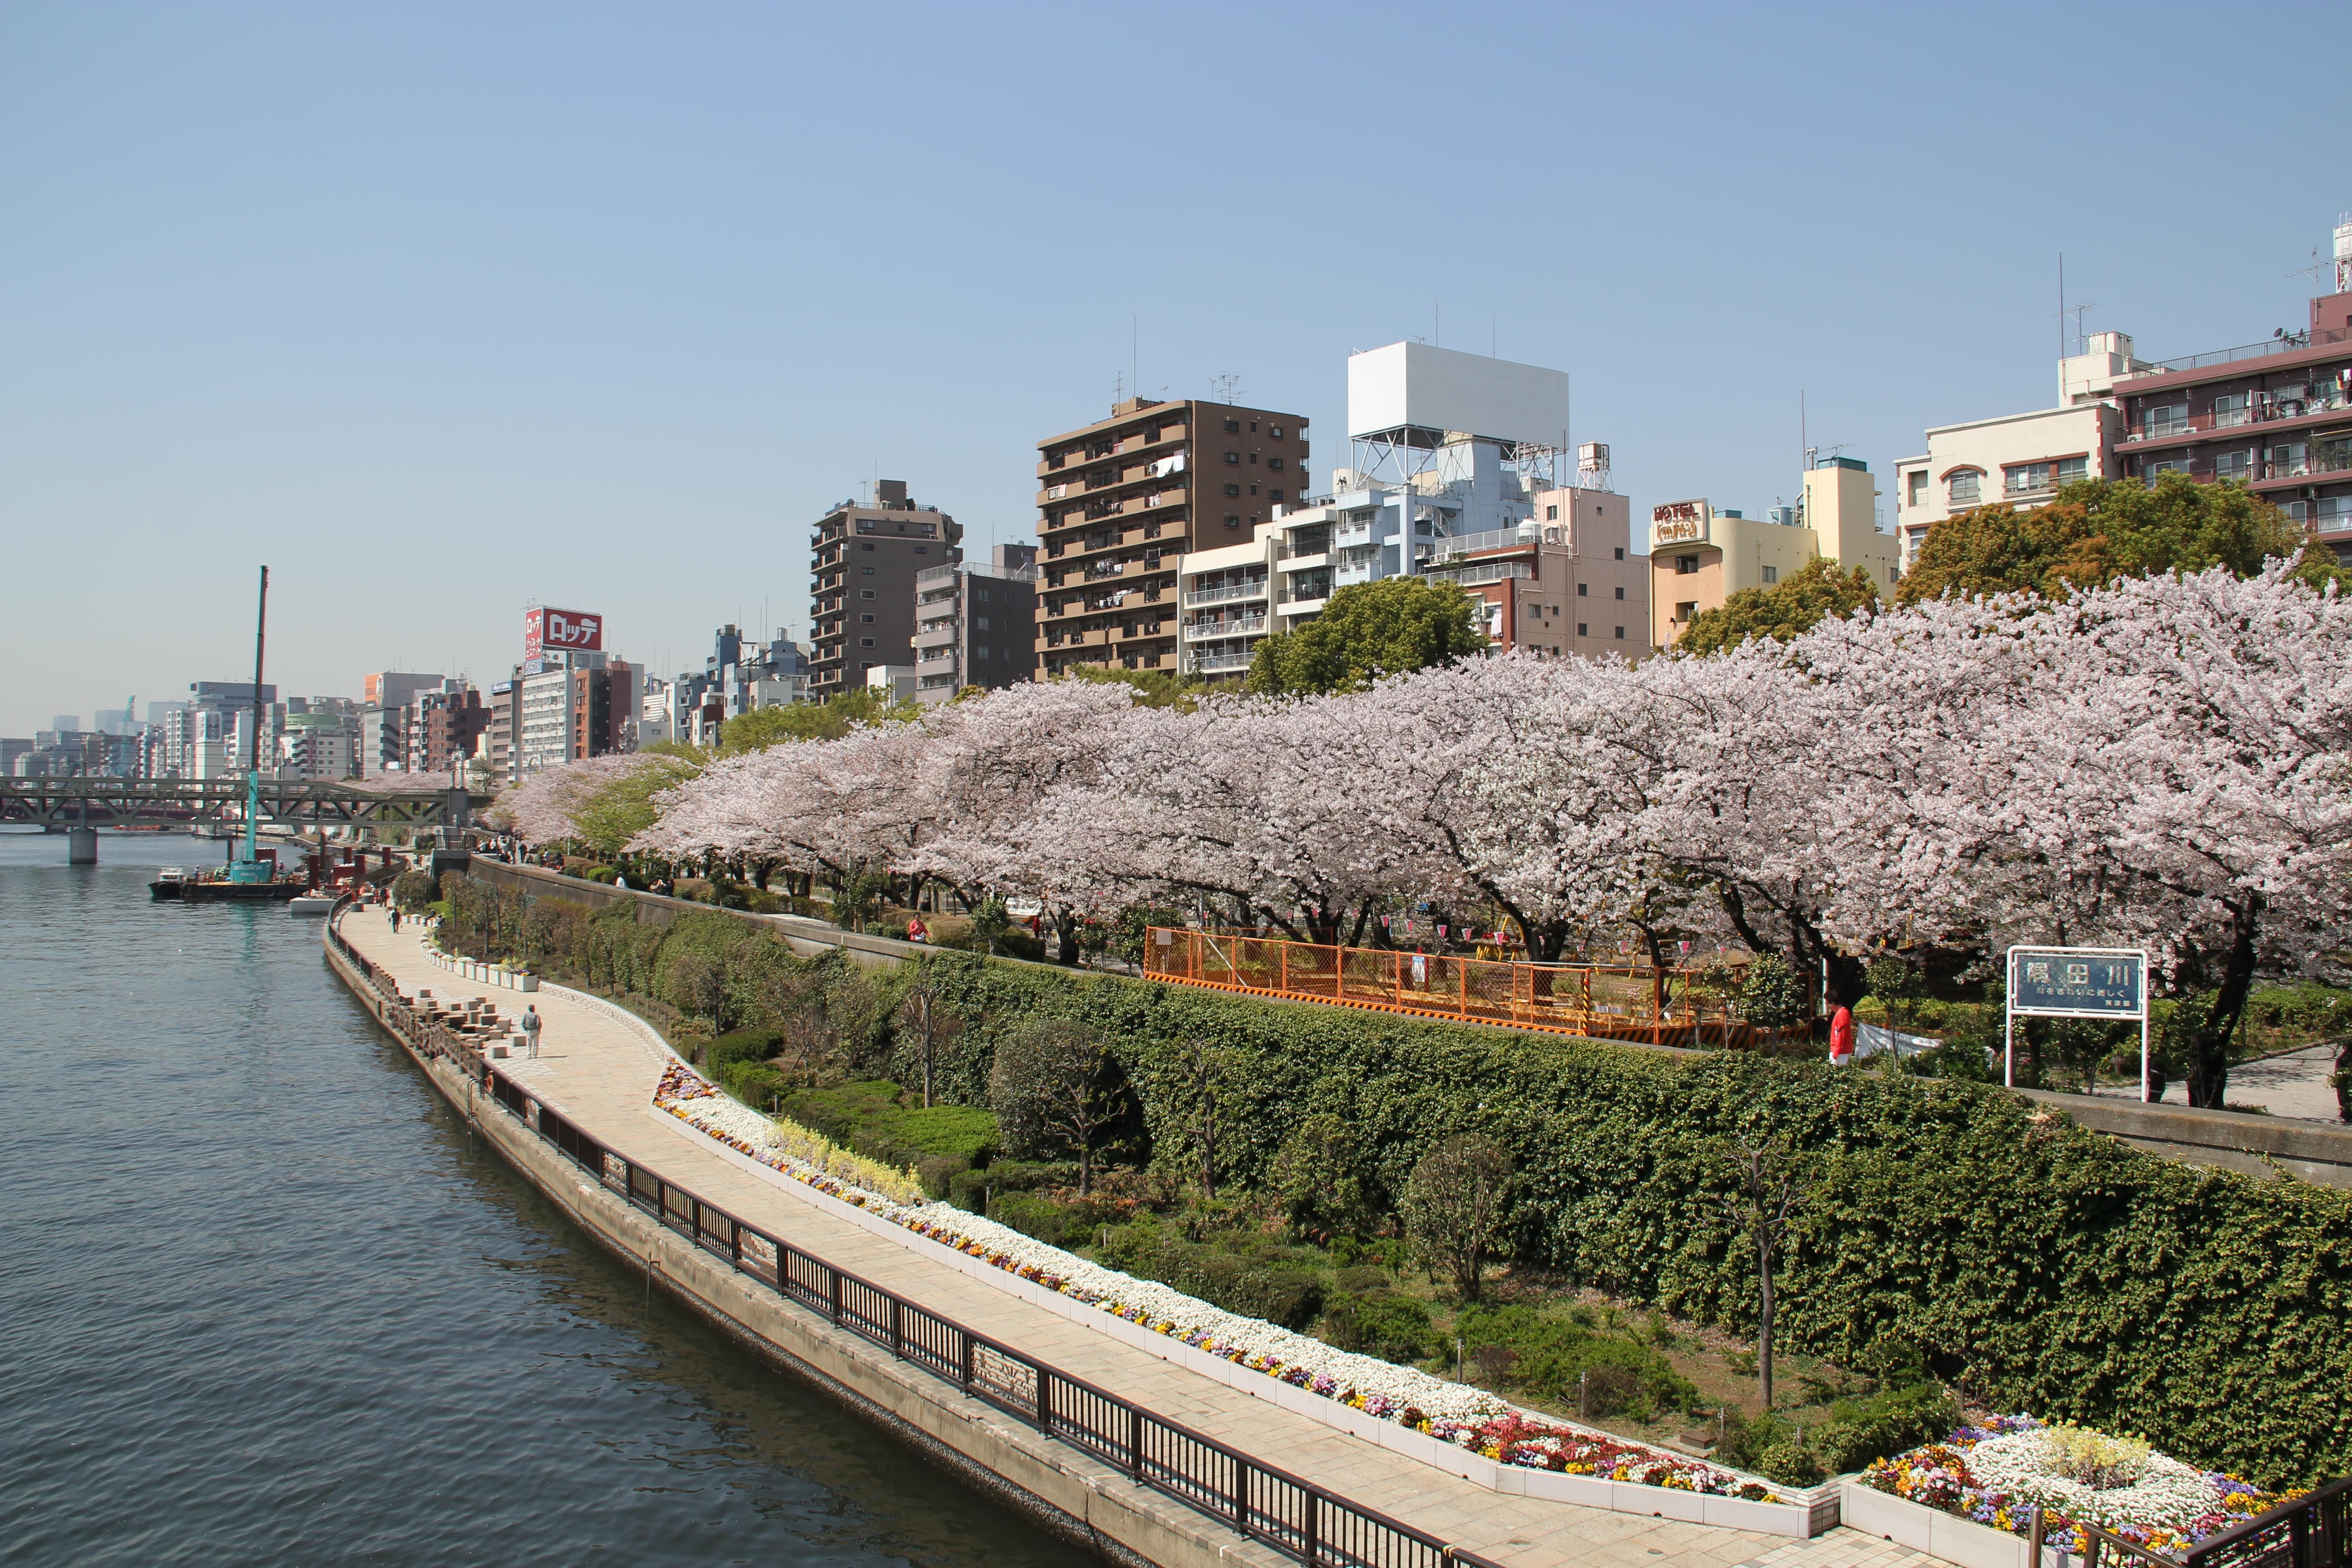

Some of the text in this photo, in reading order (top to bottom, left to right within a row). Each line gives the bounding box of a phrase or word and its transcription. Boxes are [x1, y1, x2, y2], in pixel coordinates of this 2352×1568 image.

[1654, 503, 1699, 521] HOTEL
[527, 616, 541, 634] ロッテ
[549, 614, 597, 644] ロッテ
[2026, 962, 2129, 986] 隅田川
